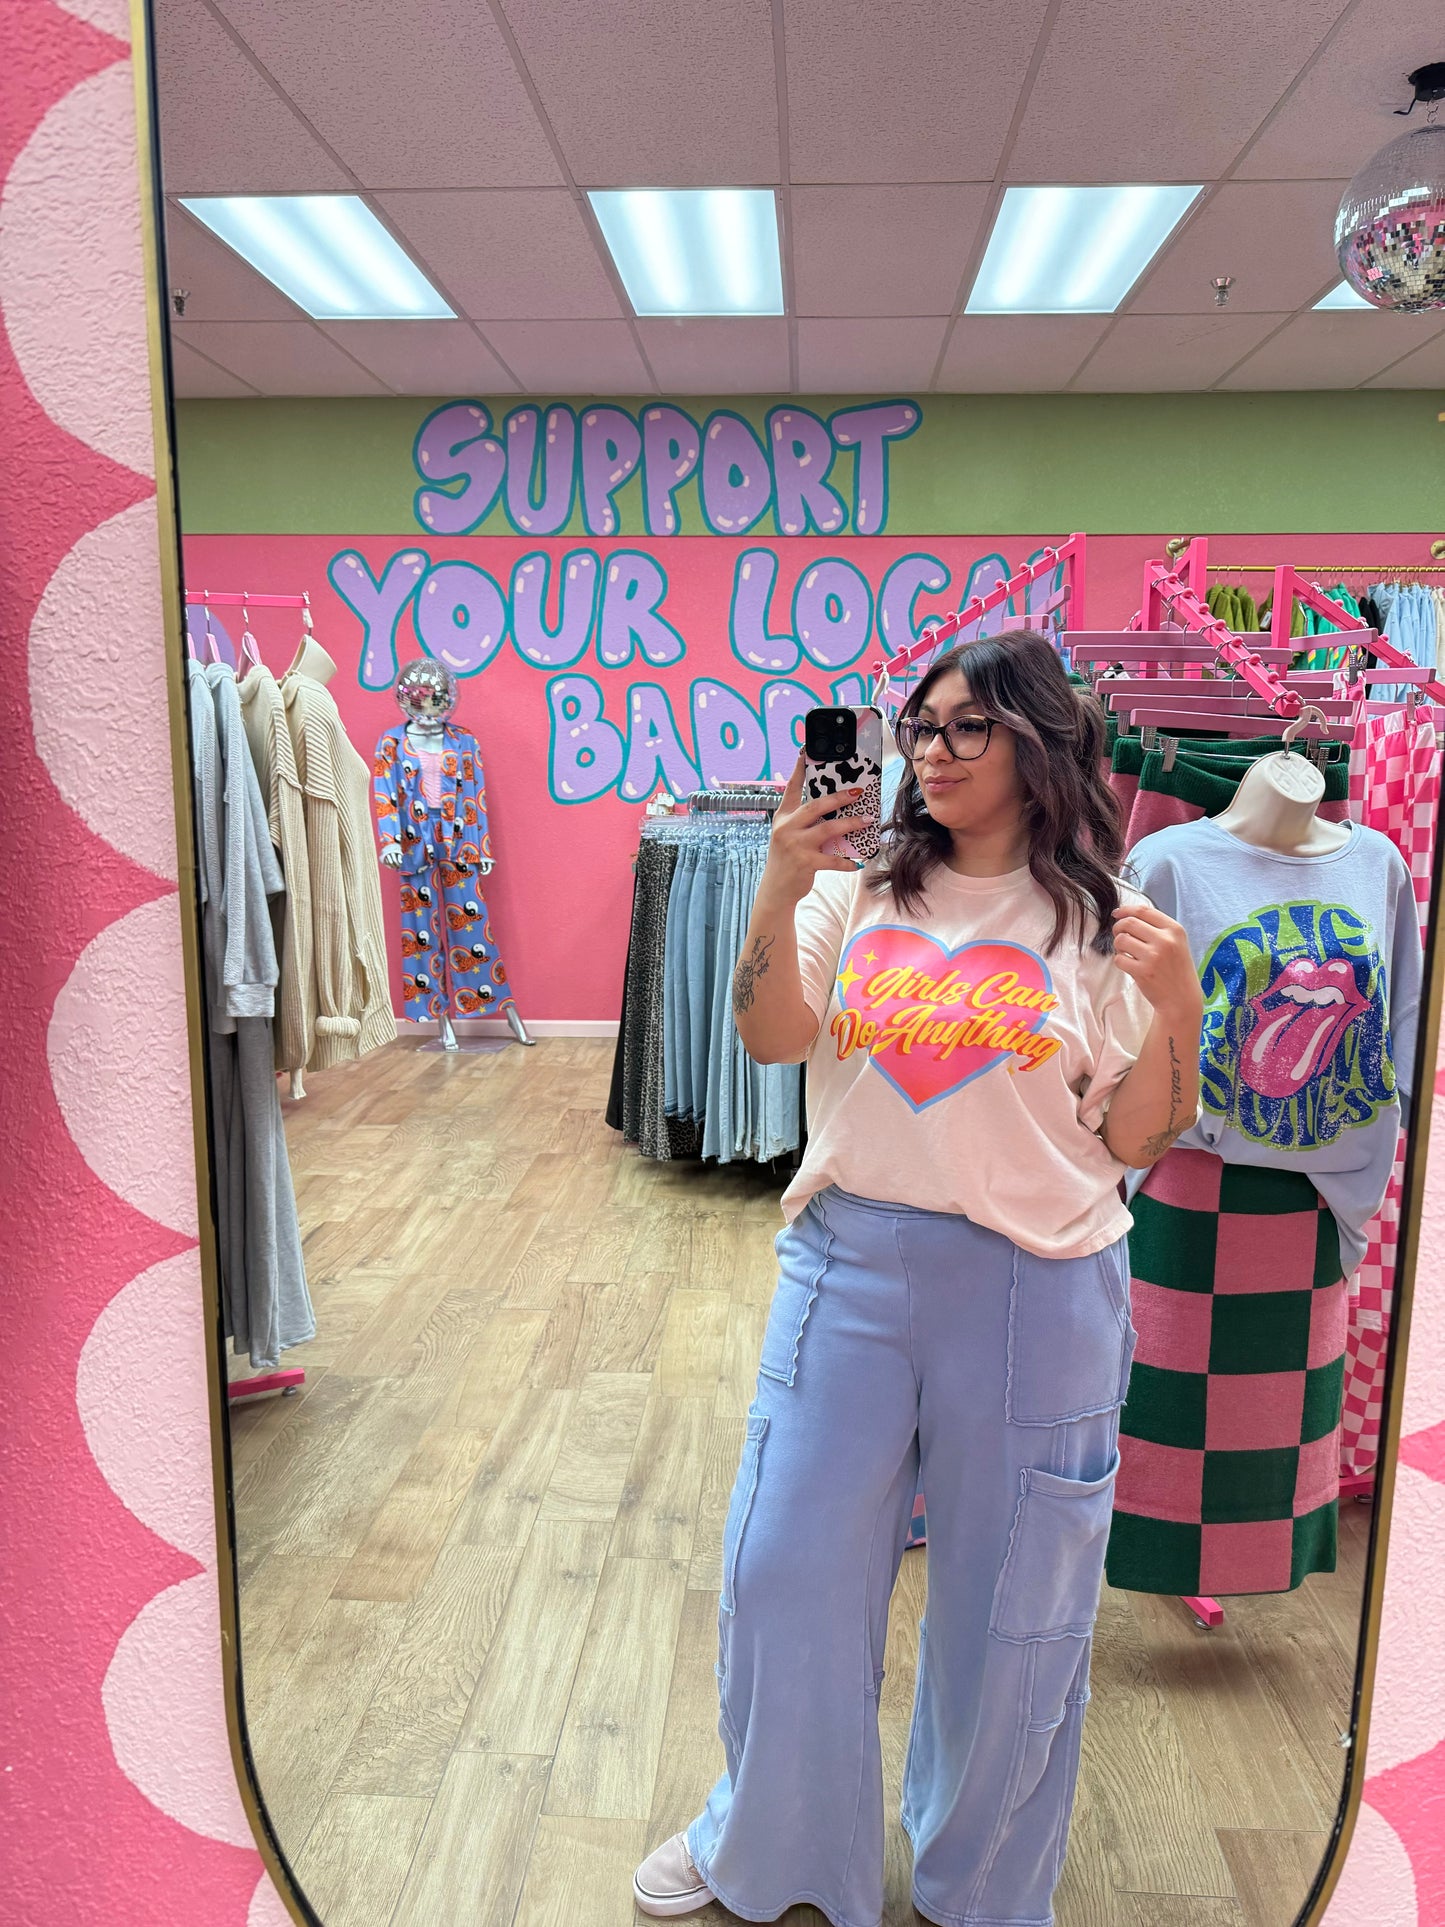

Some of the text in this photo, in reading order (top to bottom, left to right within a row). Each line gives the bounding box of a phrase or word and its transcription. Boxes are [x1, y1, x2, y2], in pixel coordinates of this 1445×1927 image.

[414, 399, 922, 536] SUPPORT
[328, 548, 685, 691] YOUR
[965, 971, 1060, 1012] Can
[1200, 904, 1372, 1008] THE
[830, 1005, 1063, 1072] Do Anything
